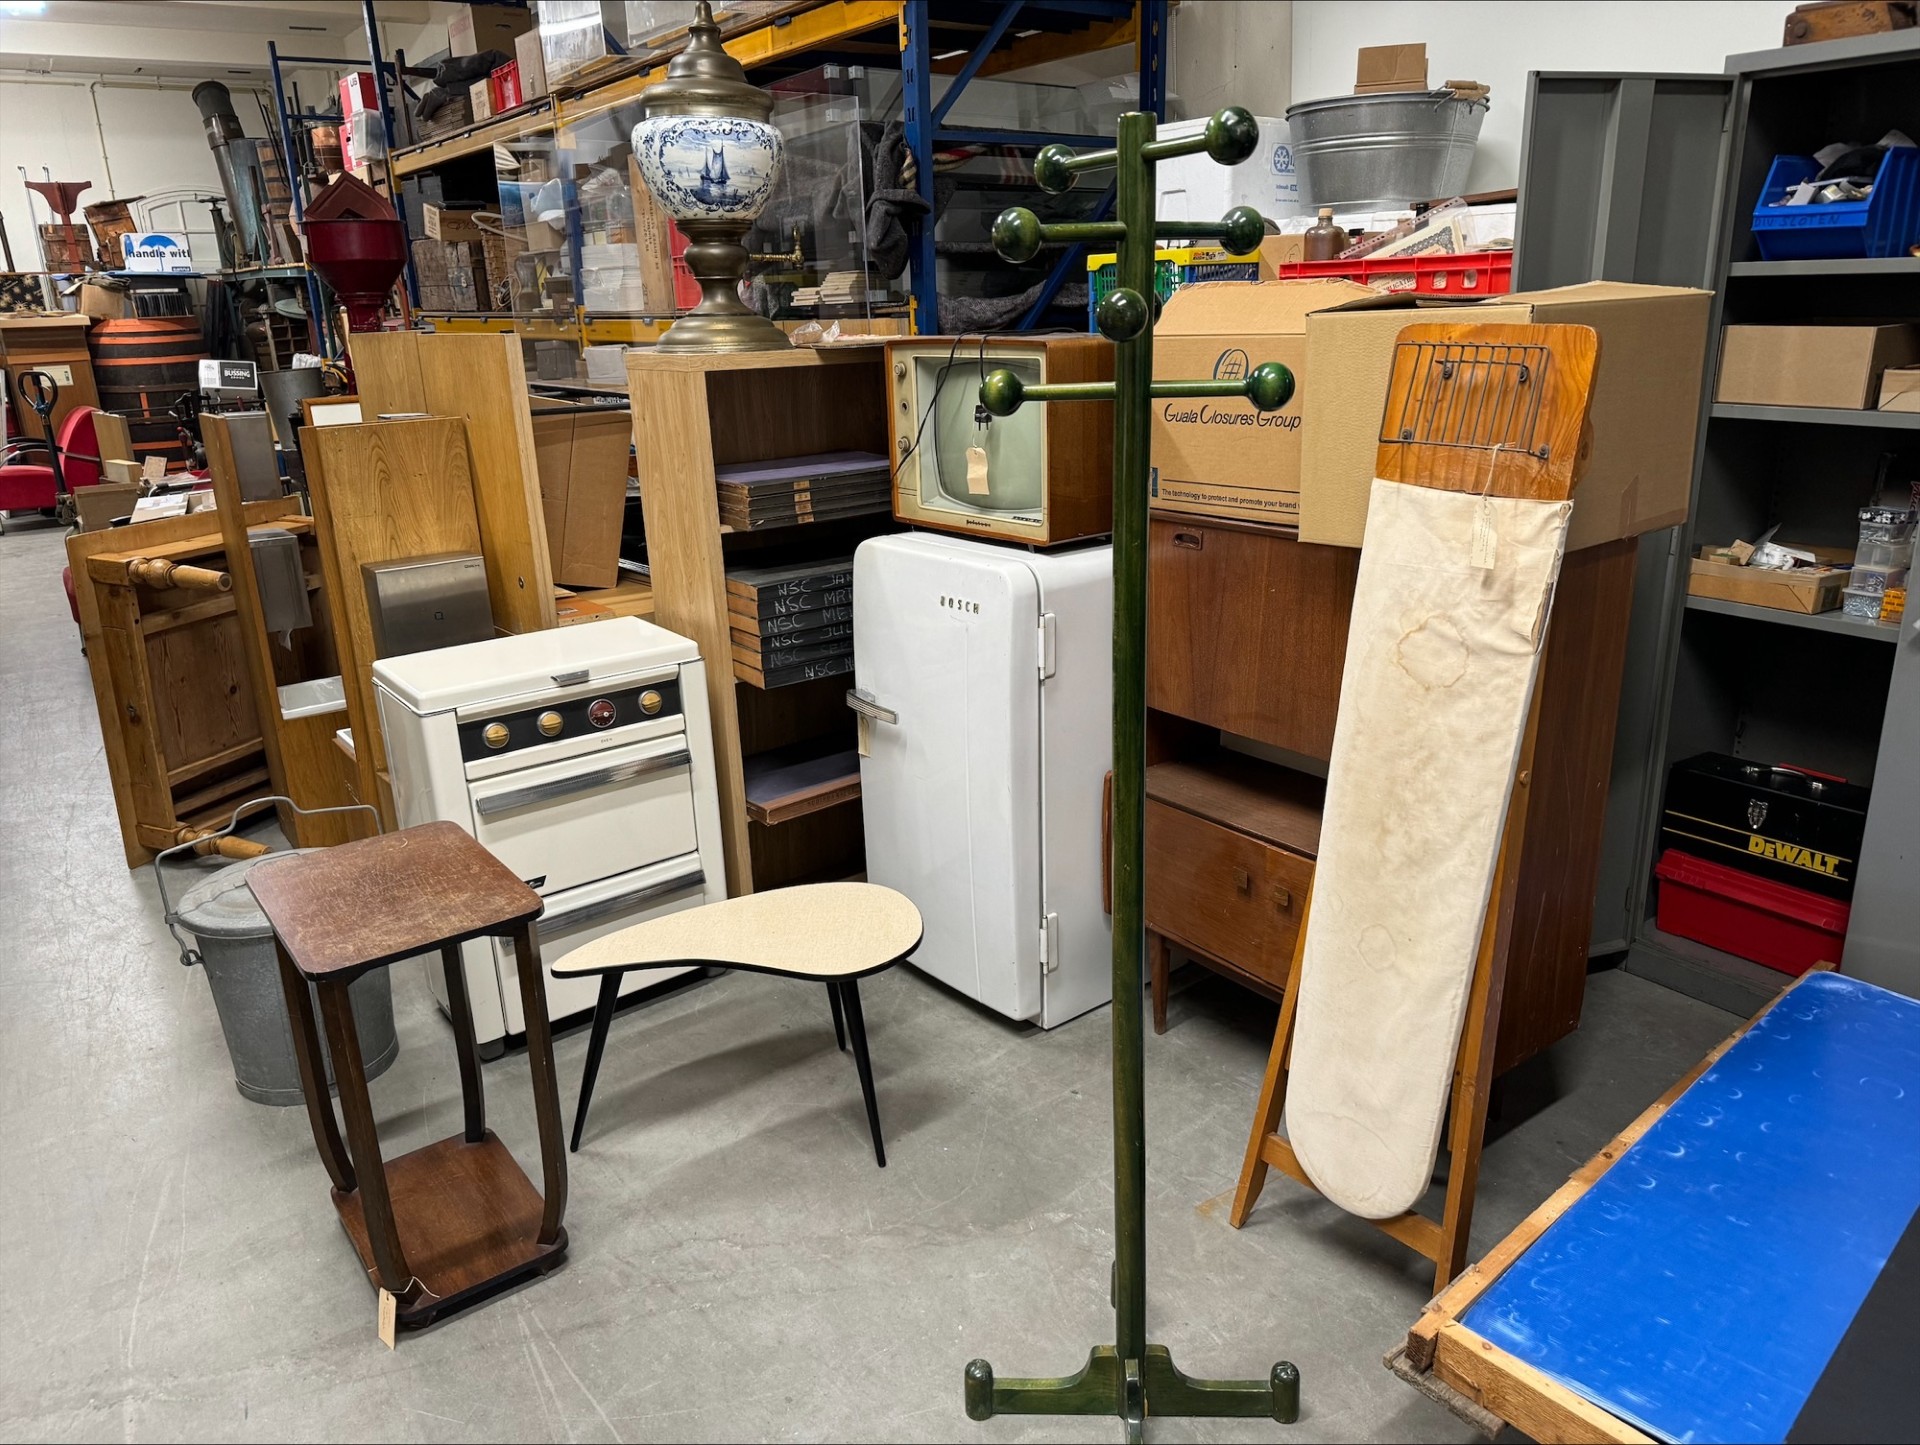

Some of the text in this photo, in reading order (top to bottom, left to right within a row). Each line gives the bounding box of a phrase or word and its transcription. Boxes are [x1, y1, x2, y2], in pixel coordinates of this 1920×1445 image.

[1164, 403, 1301, 432] Guala Closures Group
[1162, 488, 1171, 496] The
[1172, 490, 1201, 501] technology
[1208, 494, 1227, 502] protect
[1278, 500, 1297, 509] brand
[778, 579, 812, 596] NSC
[774, 594, 812, 615] NSC
[767, 613, 805, 633] NSC
[771, 632, 804, 648] NSC
[770, 648, 804, 668] NSC
[804, 662, 836, 680] NSC
